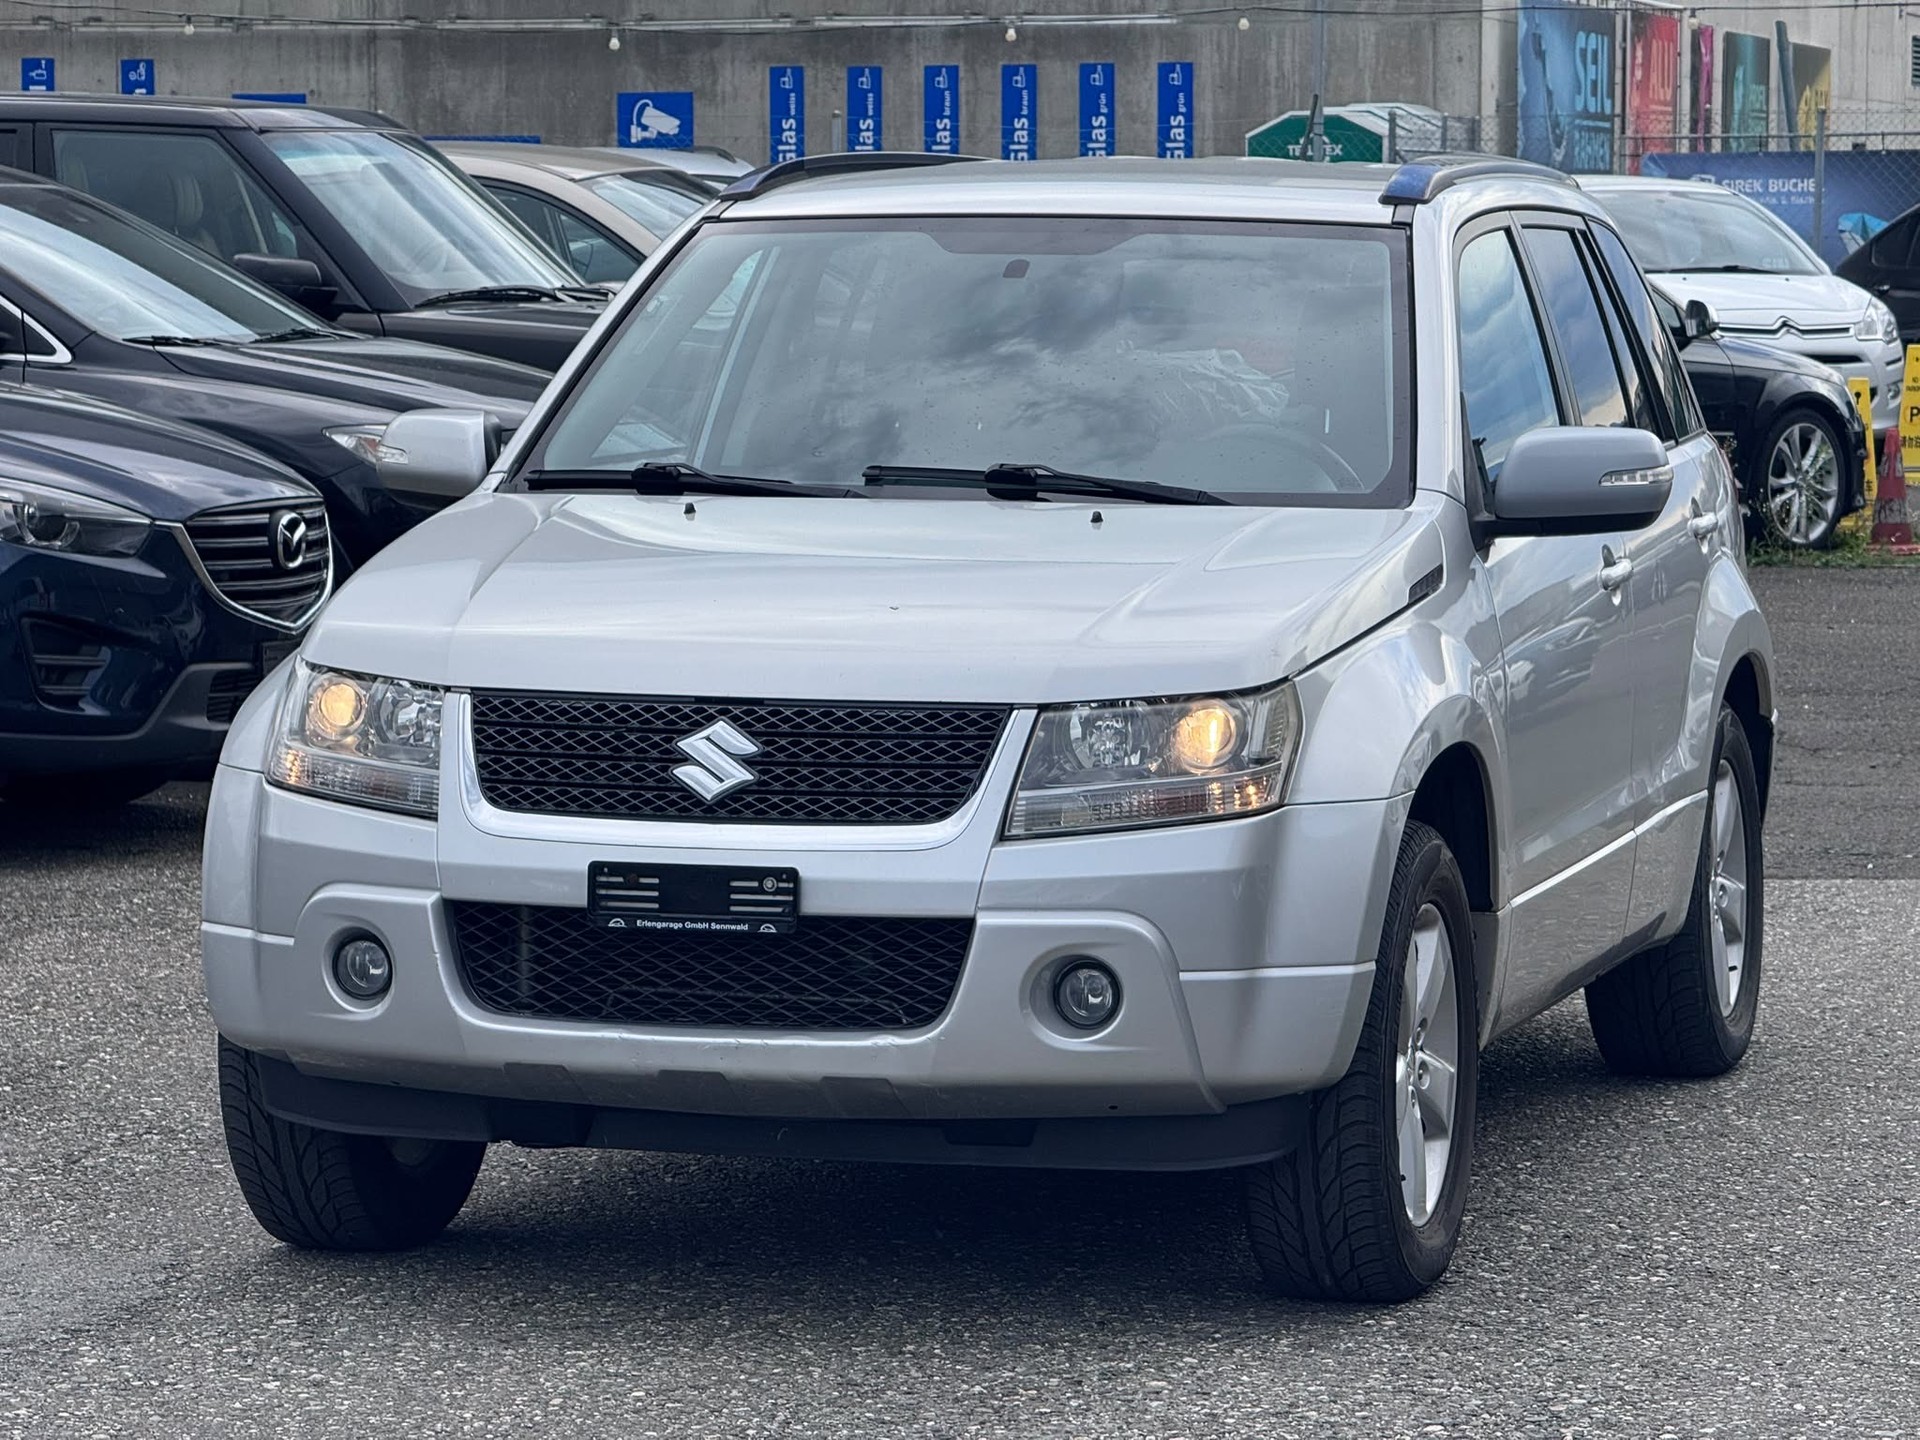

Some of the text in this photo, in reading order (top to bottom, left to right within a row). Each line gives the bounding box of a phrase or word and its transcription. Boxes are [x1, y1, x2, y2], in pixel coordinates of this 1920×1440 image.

[1575, 31, 1612, 115] SEIL
[1650, 38, 1674, 101] ALU
[932, 90, 951, 151] las braun
[1020, 89, 1029, 115] braun
[855, 118, 875, 151] las
[636, 919, 749, 931] Erlengarage GmbH Sennwald
